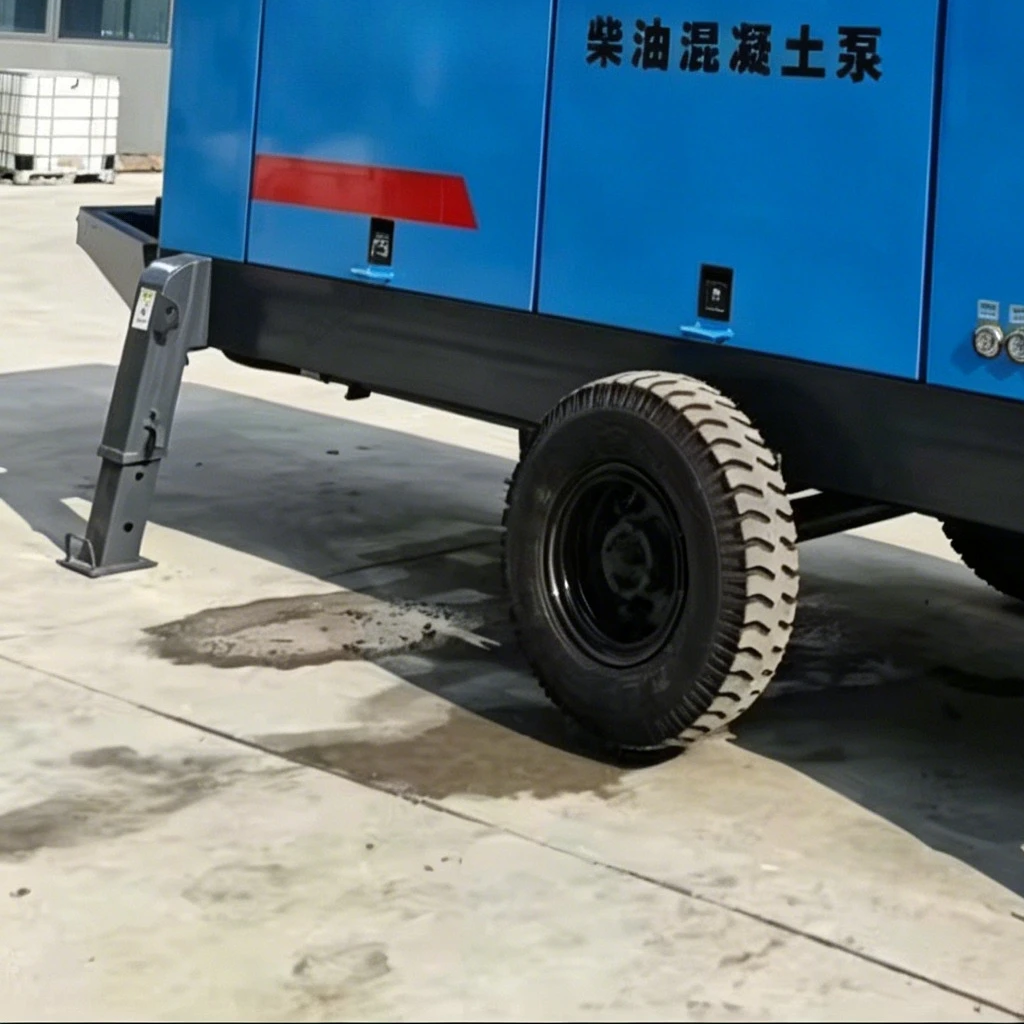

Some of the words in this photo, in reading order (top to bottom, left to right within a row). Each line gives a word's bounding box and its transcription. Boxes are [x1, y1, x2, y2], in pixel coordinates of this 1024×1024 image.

[586, 16, 882, 82] 柴油混凝土泵
